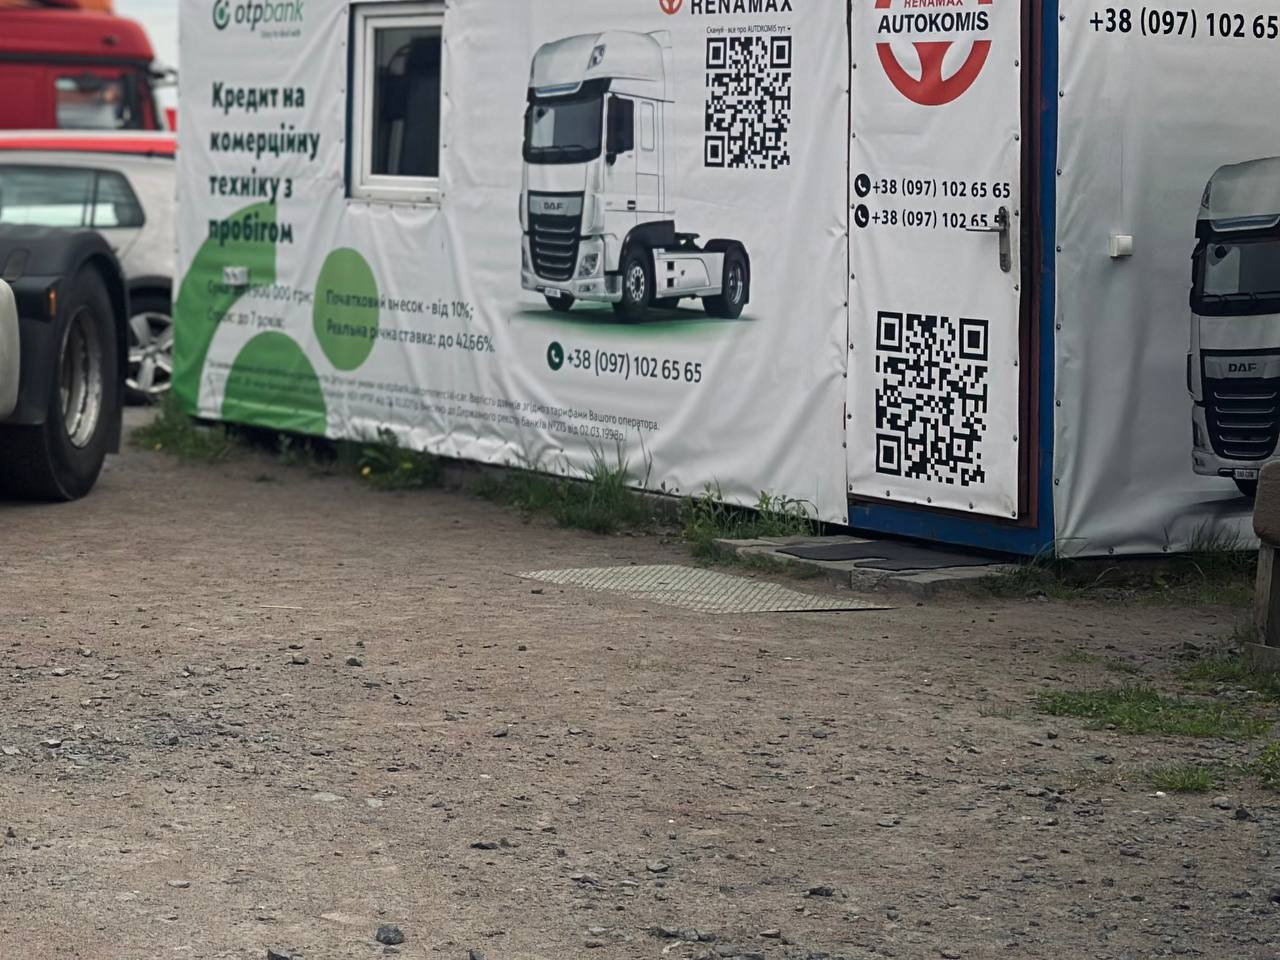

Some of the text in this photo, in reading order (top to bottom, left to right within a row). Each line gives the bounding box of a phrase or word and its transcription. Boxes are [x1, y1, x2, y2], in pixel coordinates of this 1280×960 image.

[878, 11, 989, 33] AUTOKOMIS
[1089, 7, 1279, 39] +38 (097) 102 65
[212, 81, 305, 115] Кредит на
[210, 122, 320, 161] комерційну
[209, 166, 293, 205] техніку з
[872, 178, 1011, 198] +38 (097) 102 65 65
[209, 211, 293, 247] пробігом
[871, 210, 898, 225] +38
[902, 209, 937, 229] (097)
[942, 213, 967, 228] 102
[971, 214, 988, 227] 65
[388, 298, 424, 313] внесок
[432, 299, 448, 318] від
[438, 334, 453, 349] до
[567, 349, 702, 383] +38 (097) 102 65 65
[1228, 363, 1257, 373] DAF
[589, 409, 616, 425] Вашого
